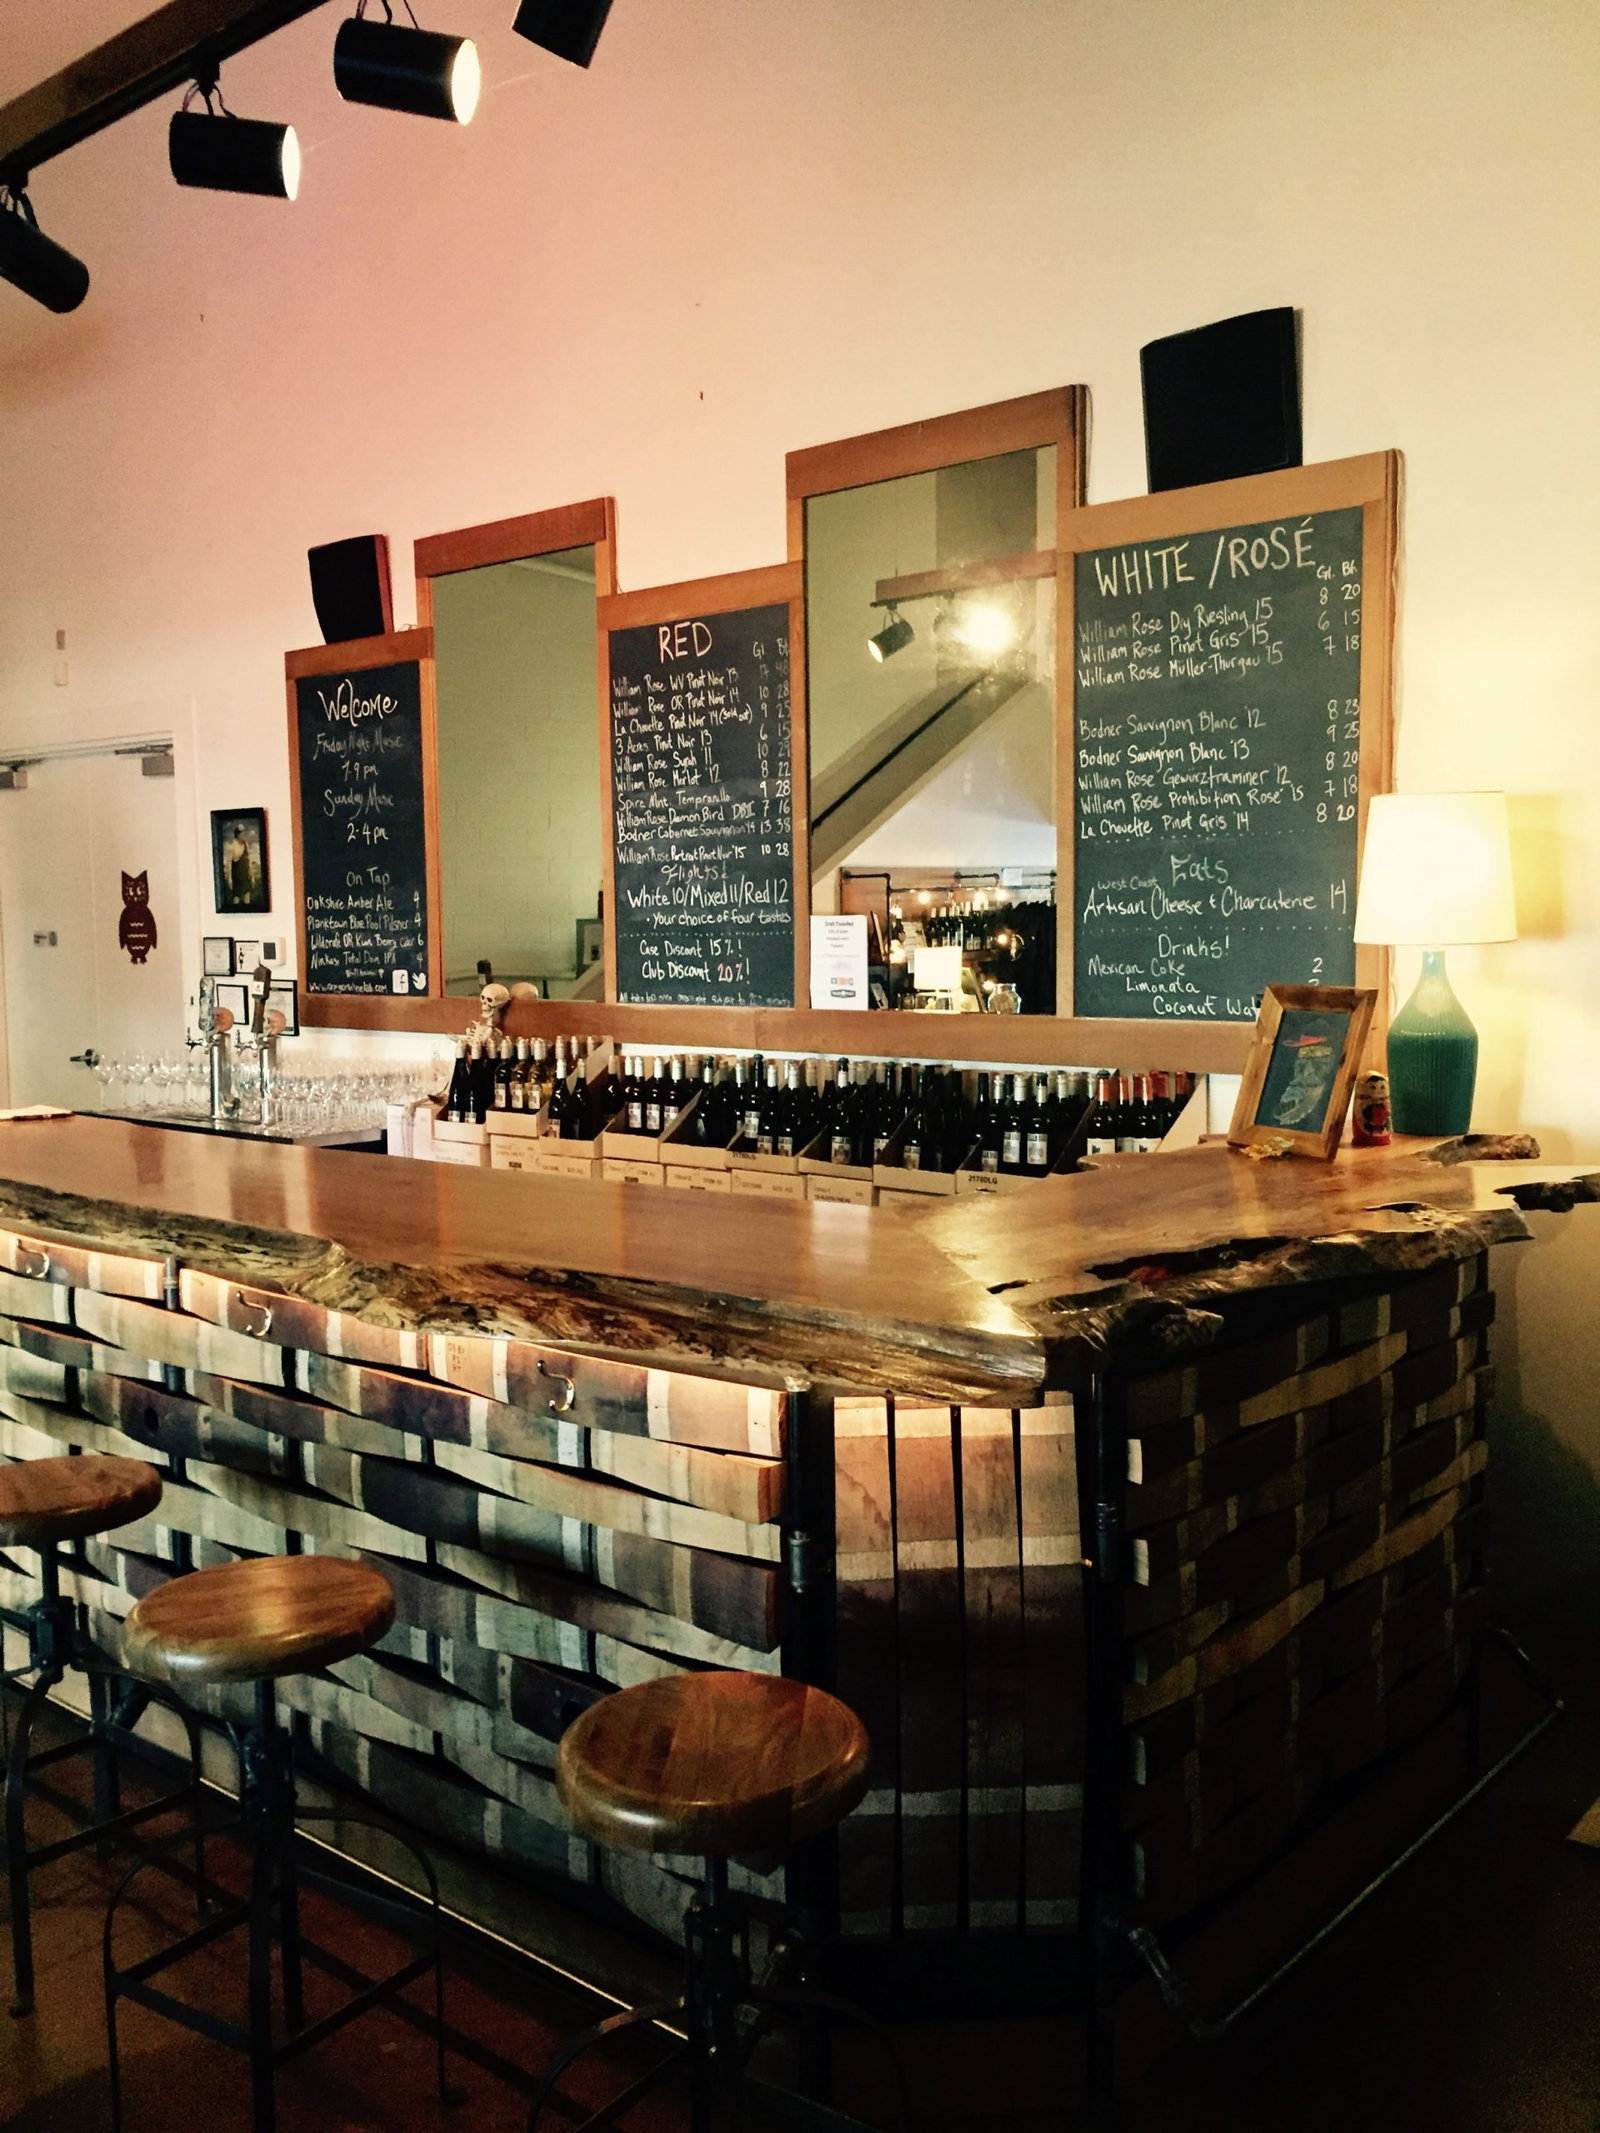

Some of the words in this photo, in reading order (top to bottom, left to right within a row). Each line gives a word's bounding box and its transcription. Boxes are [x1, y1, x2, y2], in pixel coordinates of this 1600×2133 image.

[1095, 541, 1195, 597] WHITE
[1079, 619, 1129, 643] William
[1132, 612, 1163, 638] Rose
[1170, 611, 1192, 641] Dry
[1194, 604, 1249, 636] Riesling
[1320, 587, 1328, 605] 8
[1341, 584, 1361, 600] 20
[659, 622, 712, 663] RED
[1080, 645, 1128, 664] William
[1132, 641, 1162, 659] Rose
[1170, 632, 1204, 656] Pinot
[1209, 631, 1240, 650] Gris
[1318, 611, 1330, 630] 6
[1345, 609, 1361, 626] 15
[1079, 666, 1125, 688] William
[1128, 663, 1163, 682] Rose
[1322, 635, 1336, 655] 7
[1346, 634, 1360, 653] 18
[613, 676, 642, 698] William
[643, 674, 667, 693] Rose
[686, 669, 706, 689] Pinot
[317, 679, 398, 727] Welcome
[648, 696, 665, 713] Rose
[671, 695, 685, 711] OR
[685, 691, 706, 709] Pinot
[708, 690, 726, 706] Noir
[759, 685, 769, 700] 10
[615, 719, 627, 737] La
[668, 711, 687, 730] Pinot
[688, 711, 706, 729] Noir
[1080, 718, 1122, 741] Bodner
[1127, 714, 1194, 746] Sauvignon
[1198, 711, 1239, 733] Blanc
[1327, 699, 1338, 720] 8
[1345, 698, 1360, 716] 23
[615, 738, 624, 756] 3
[627, 736, 649, 754] Acres
[653, 732, 673, 752] Pinot
[677, 732, 696, 749] Noir
[1079, 746, 1121, 768] Bodner
[1127, 744, 1184, 773] Sauvignon
[1189, 742, 1228, 764] Blanc
[1326, 724, 1337, 743] 9
[1344, 721, 1360, 739] 25
[614, 756, 644, 774] William
[646, 753, 668, 770] Rose
[673, 750, 697, 774] Syrah
[1078, 772, 1122, 791] William
[1125, 769, 1155, 789] Rose
[1326, 751, 1336, 771] 8
[1343, 750, 1359, 768] 20
[615, 774, 646, 792] William
[647, 772, 669, 788] Rose
[673, 768, 702, 787] Merlot
[323, 787, 363, 821] Sunday
[618, 793, 646, 813] Spire
[759, 780, 767, 798] 9
[775, 779, 791, 798] 28
[1081, 794, 1126, 815] William
[1131, 792, 1163, 813] Rose
[1168, 789, 1242, 809] Prohibition
[1324, 780, 1336, 797] 7
[1343, 774, 1358, 798] 18
[616, 811, 647, 829] William
[645, 809, 668, 825] Rose
[669, 807, 702, 825] Demon
[702, 805, 724, 823] Bird
[1080, 821, 1096, 839] La
[1100, 816, 1153, 837] Chouette
[1162, 811, 1192, 831] Pinot
[1199, 814, 1228, 832] Gris
[1316, 802, 1328, 823] 8
[1337, 804, 1356, 822] 20
[617, 826, 657, 844] Bodner
[657, 825, 700, 839] Cabernet
[616, 846, 649, 865] William
[761, 844, 771, 856] 10
[776, 842, 790, 857] 28
[346, 872, 363, 887] On
[366, 866, 390, 893] Tap
[1171, 854, 1230, 886] Eats
[347, 894, 374, 910] Amber
[375, 894, 395, 912] Ale
[627, 885, 671, 909] White
[775, 878, 790, 905] 12
[1083, 887, 1148, 924] Artisan
[1151, 885, 1203, 919] Cheese
[1331, 879, 1347, 915] 14
[348, 914, 366, 930] Blue
[365, 913, 382, 930] Pool
[653, 911, 676, 930] your
[678, 909, 715, 926] choice
[716, 911, 730, 924] of
[731, 909, 754, 924] four
[758, 909, 792, 925] tastes
[383, 951, 398, 965] IPA
[640, 939, 662, 956] Case
[664, 939, 702, 958] Discount
[1158, 933, 1230, 959] Drinks!
[642, 959, 666, 981] Club
[667, 961, 712, 983] Discount
[1088, 954, 1144, 976] Mexican
[1151, 957, 1186, 977] Coke
[1313, 957, 1323, 973] 2
[1126, 976, 1201, 993] Limonata
[1153, 995, 1218, 1017] Coconut
